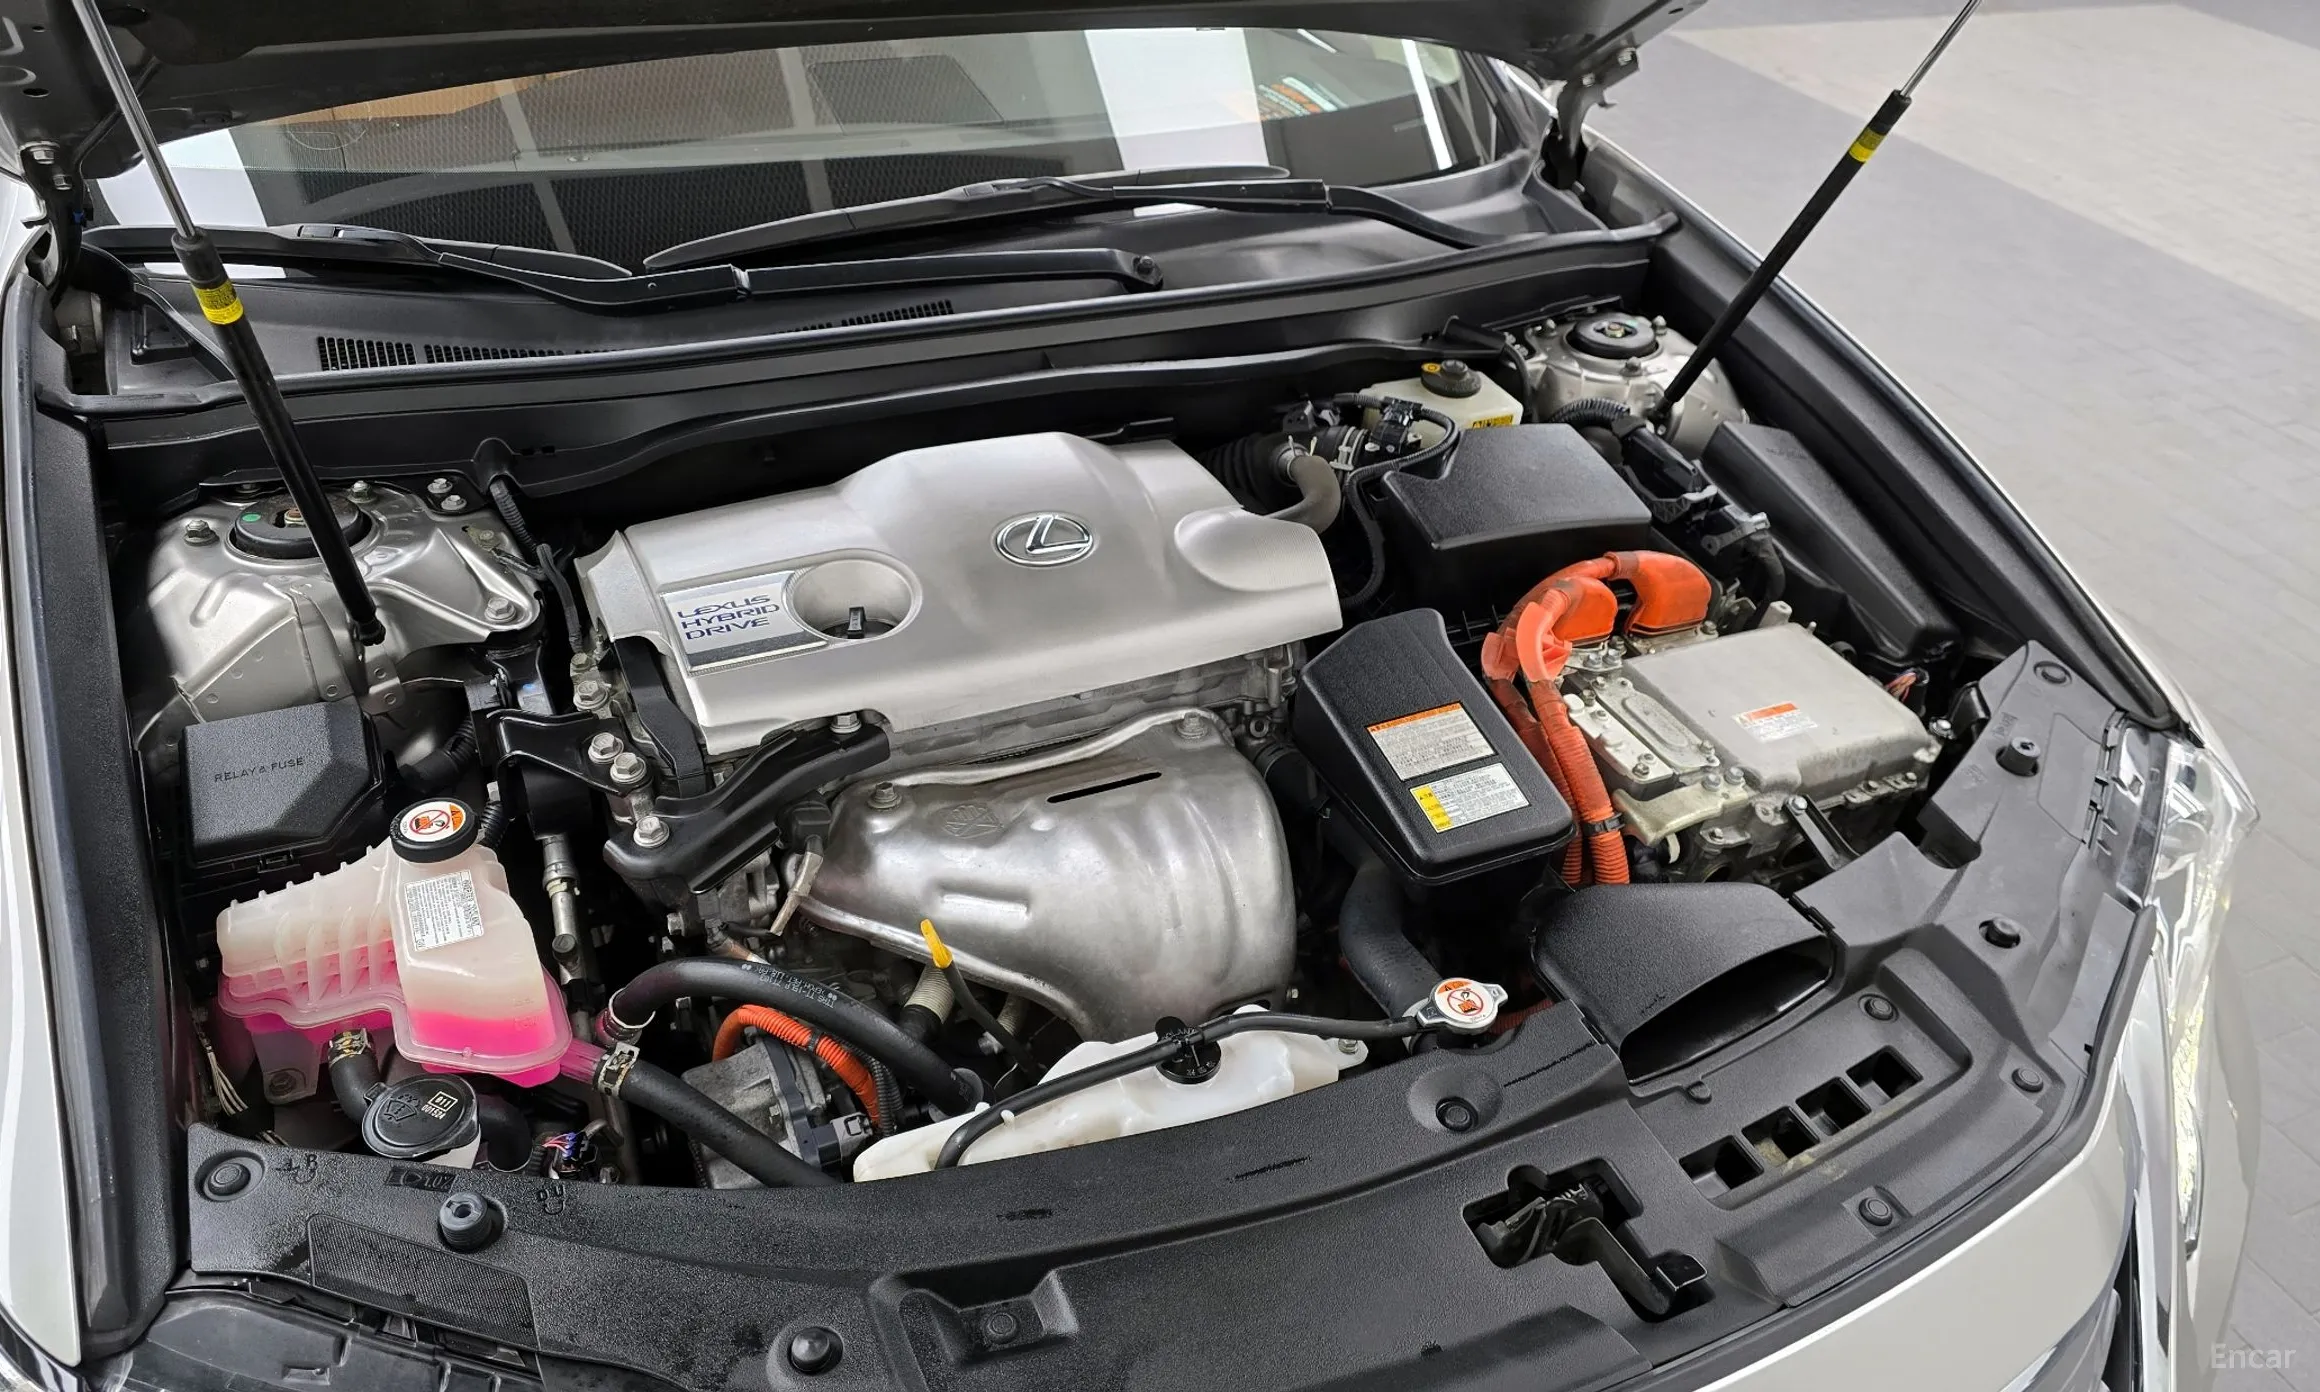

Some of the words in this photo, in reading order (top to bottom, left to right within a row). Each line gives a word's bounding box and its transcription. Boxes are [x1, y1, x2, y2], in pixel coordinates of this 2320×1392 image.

[677, 594, 771, 619] LEXUS
[681, 604, 780, 630] HYBRID
[686, 617, 770, 640] DRIVE
[214, 767, 256, 783] RELAY
[271, 757, 304, 771] FUSE
